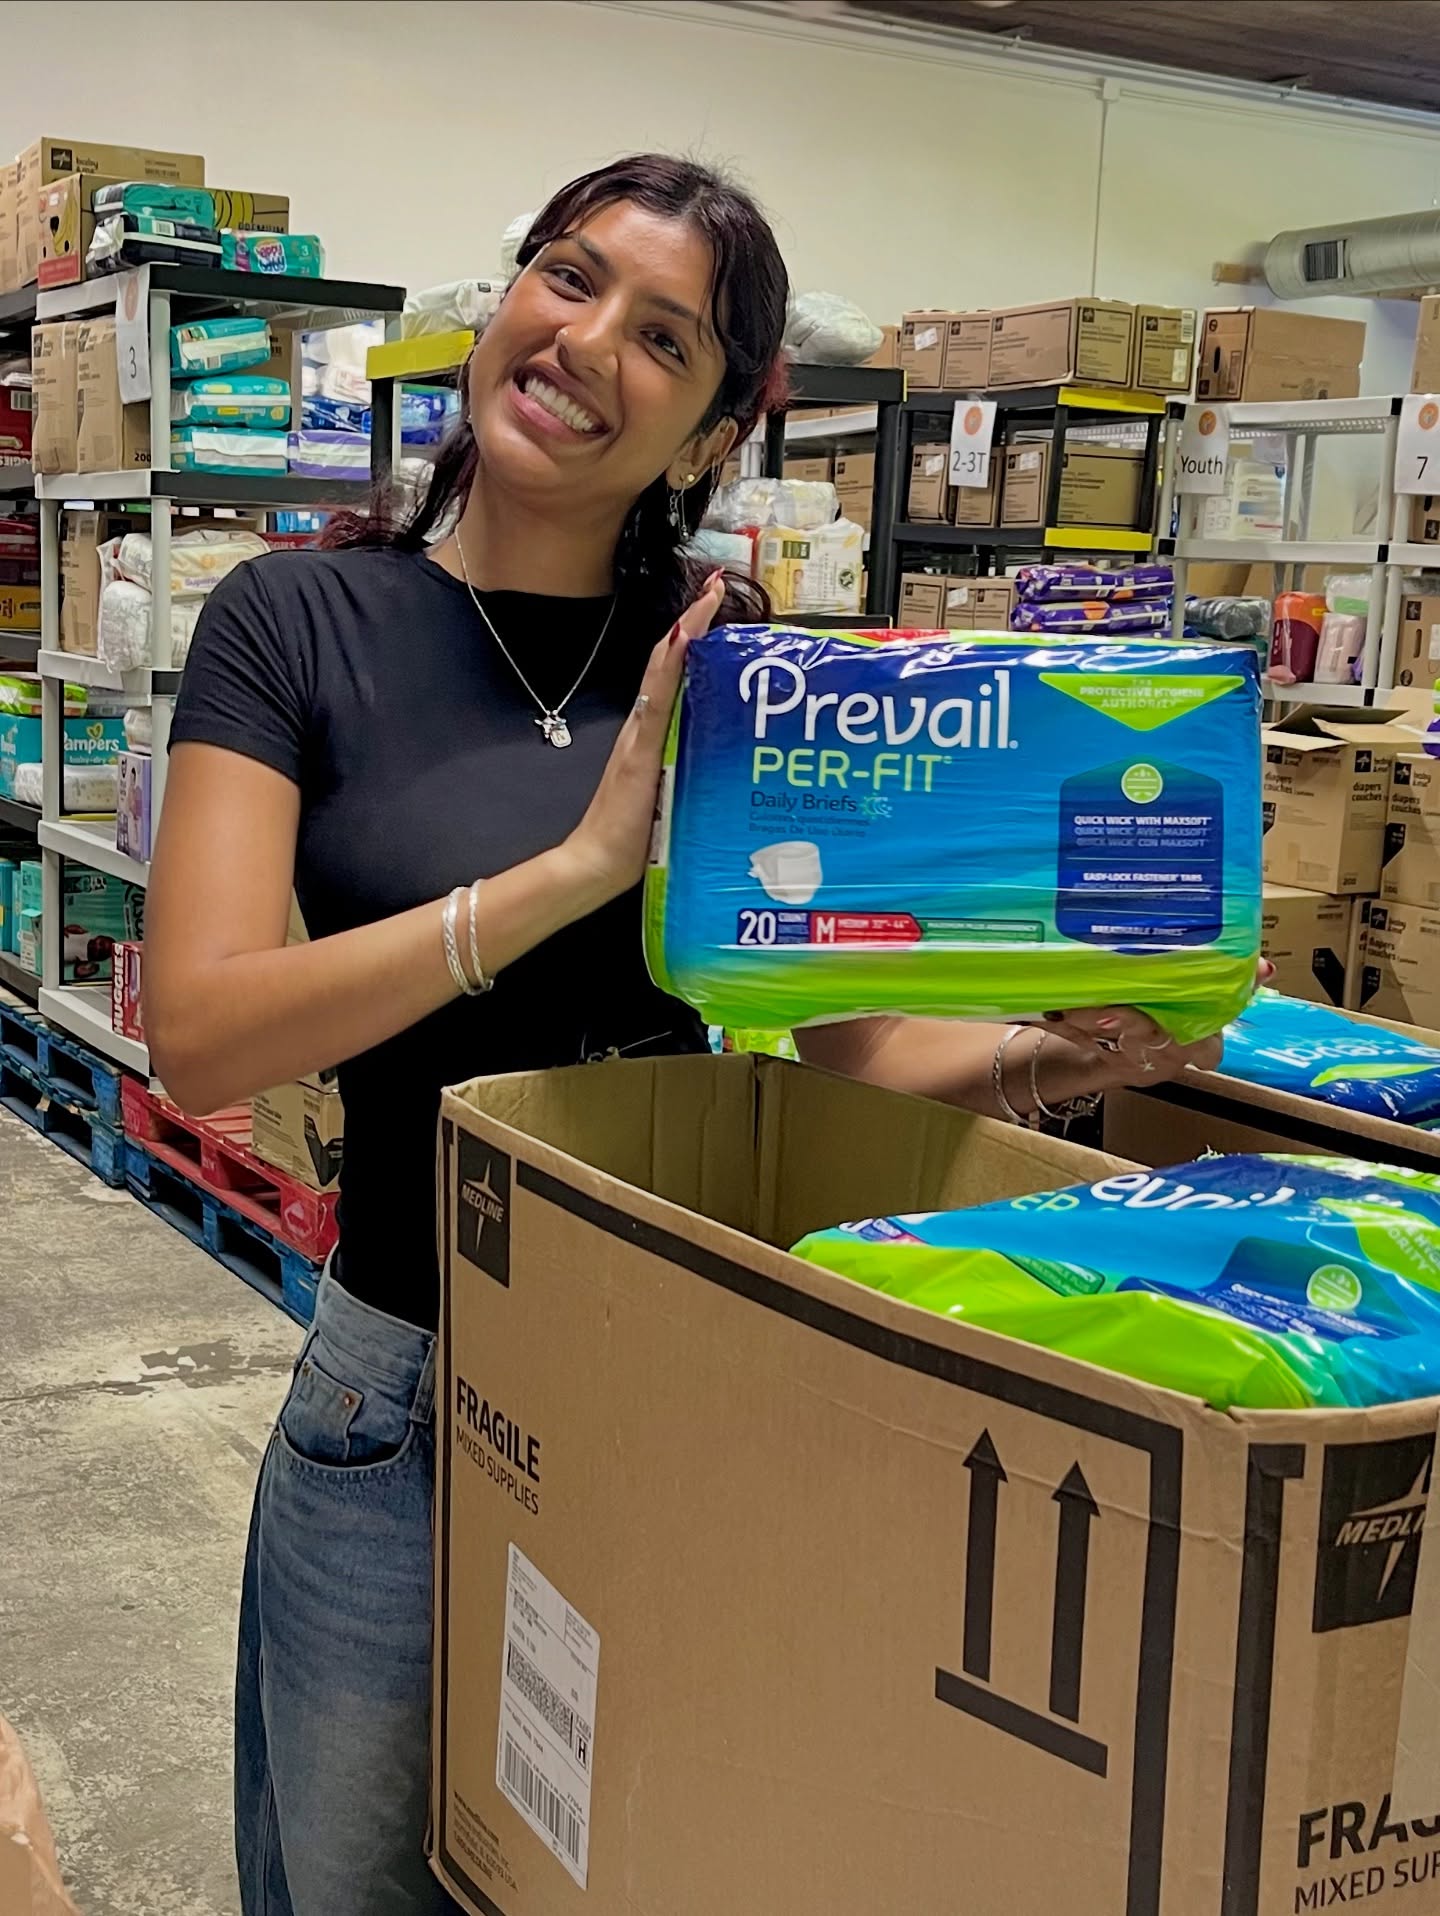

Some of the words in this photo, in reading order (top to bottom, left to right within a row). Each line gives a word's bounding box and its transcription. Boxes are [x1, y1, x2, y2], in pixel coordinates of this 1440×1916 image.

[130, 346, 137, 379] 3
[952, 450, 987, 473] 2-3T
[1181, 455, 1223, 475] Youth
[1416, 456, 1428, 480] 7
[739, 656, 1012, 749] Prevail
[1080, 686, 1151, 697] PROTECTIVE
[63, 731, 119, 754] ampers
[752, 746, 943, 793] PER-FIT
[1264, 772, 1292, 785] diapers
[1352, 793, 1382, 802] couches
[1353, 781, 1381, 792] diapers
[1392, 793, 1421, 805] diapers
[751, 791, 797, 813] Daily
[802, 793, 857, 812] Briefs
[1391, 804, 1421, 815] couches
[739, 910, 777, 945] 20
[816, 916, 836, 943] M
[113, 943, 125, 1036] HUGGIES
[461, 1183, 505, 1223] MEDLINE
[456, 1375, 541, 1483] FRAGILE
[456, 1425, 485, 1468] MIXED
[487, 1456, 540, 1516] SUPPLIES
[1335, 1509, 1426, 1548] MEDLI
[577, 1736, 587, 1765] H
[1294, 1866, 1385, 1914] MIXED
